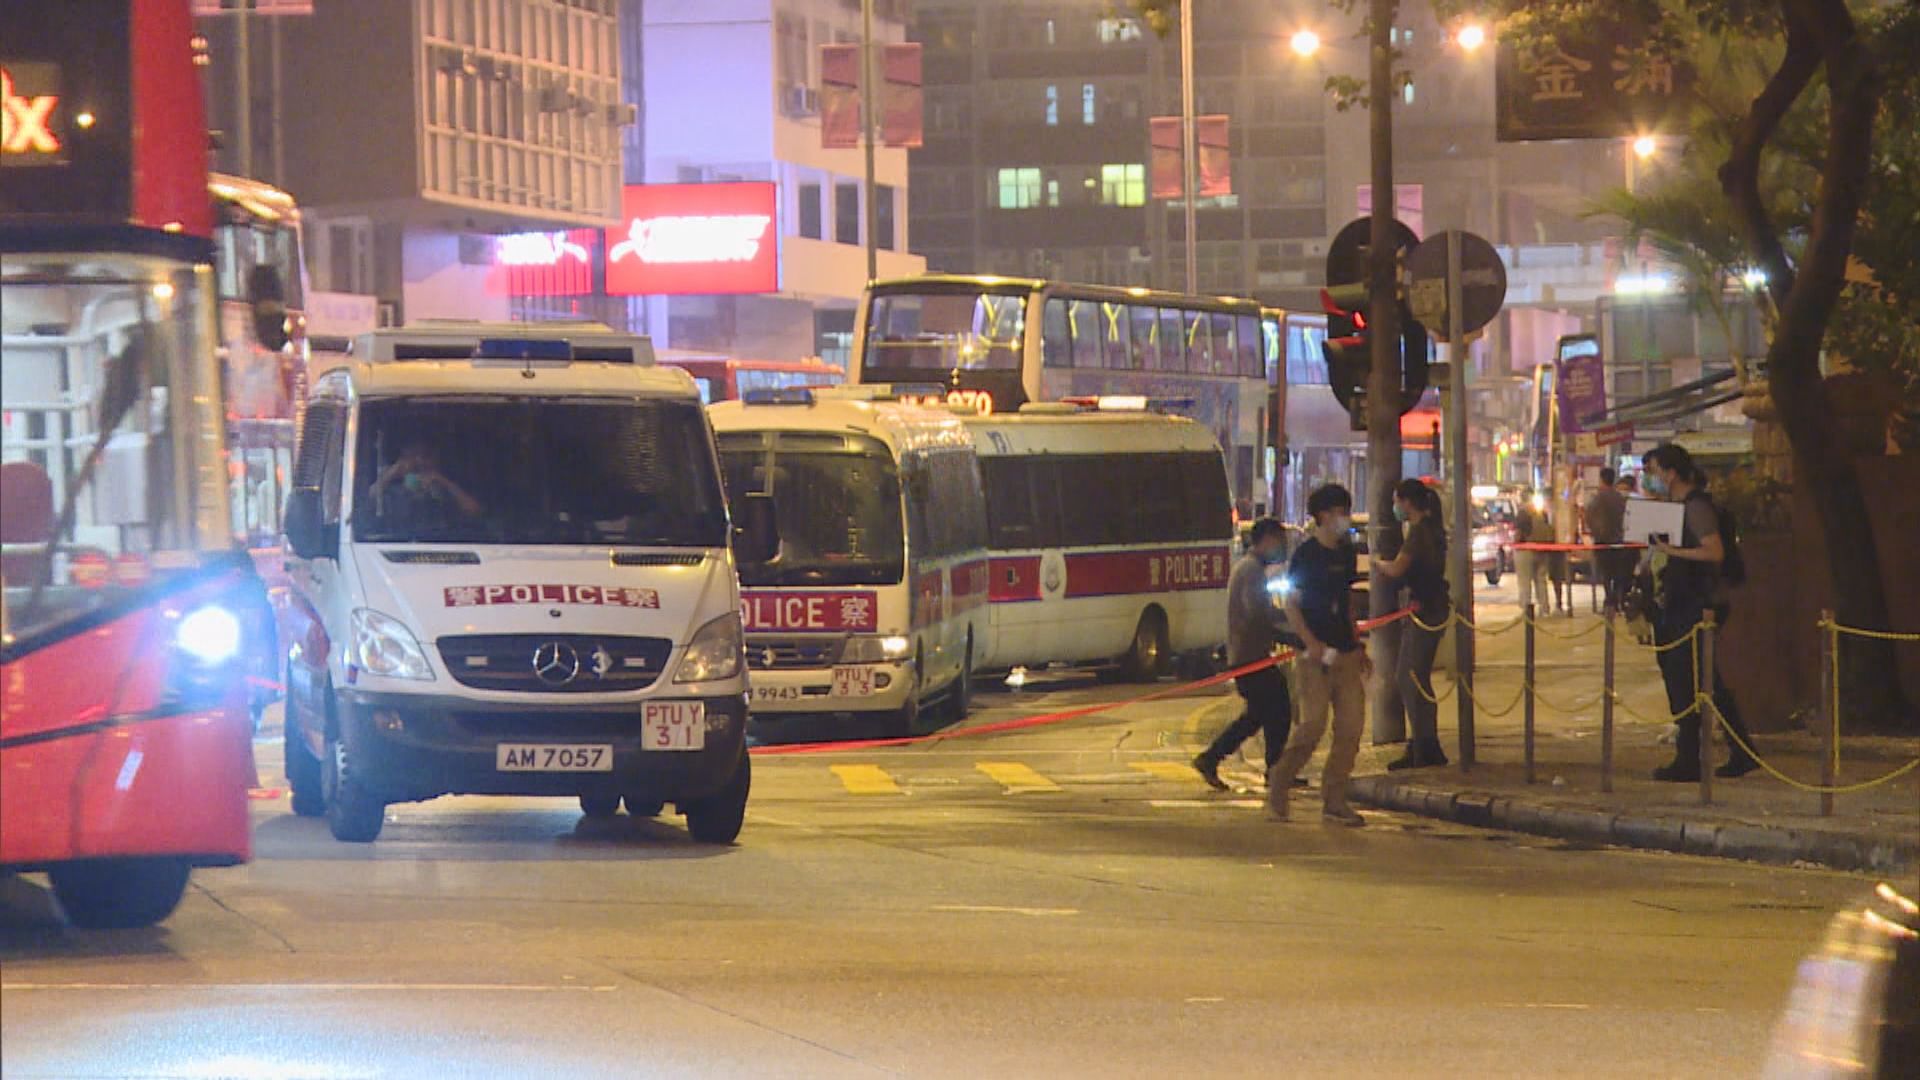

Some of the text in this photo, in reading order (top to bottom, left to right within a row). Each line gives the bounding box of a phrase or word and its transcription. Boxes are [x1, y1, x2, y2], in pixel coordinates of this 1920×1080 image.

[947, 388, 992, 416] 970
[1165, 553, 1208, 584] POLICE
[484, 584, 620, 606] POLICE
[840, 597, 869, 627] 察
[834, 665, 873, 681] PTU Y
[758, 686, 798, 700] 9943
[646, 703, 700, 725] PTU Y
[505, 749, 603, 767] AM 7057
